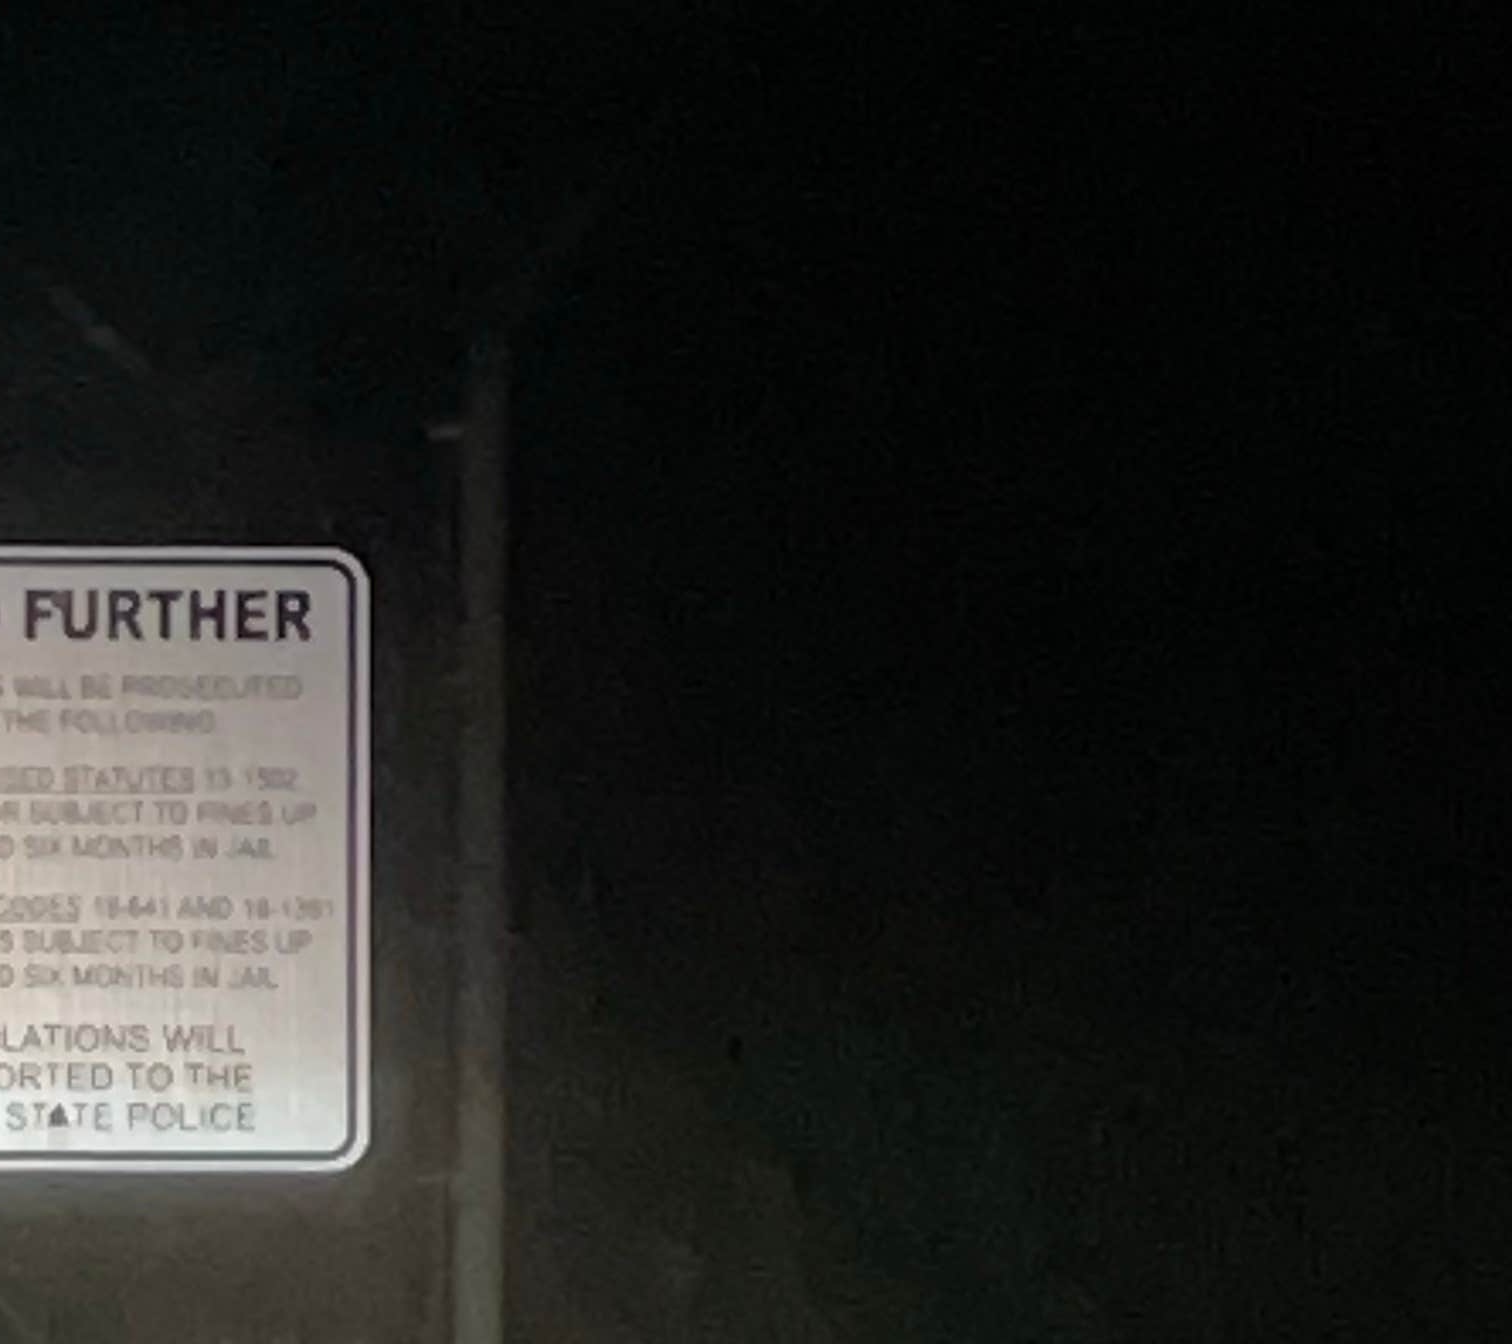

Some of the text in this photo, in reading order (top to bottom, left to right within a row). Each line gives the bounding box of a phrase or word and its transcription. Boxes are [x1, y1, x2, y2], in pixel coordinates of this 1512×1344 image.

[23, 588, 313, 643] FURTHER
[80, 674, 112, 700] BE
[1, 709, 50, 733] THE
[152, 800, 189, 826] TO
[282, 803, 317, 825] UP
[71, 834, 184, 860] MONTHS
[191, 837, 218, 859] IN
[177, 896, 234, 920] AND
[149, 930, 184, 954] TO
[275, 930, 312, 954] UP
[71, 964, 184, 989] MONTHS
[192, 965, 220, 988] IN
[162, 1024, 245, 1056] WILL
[125, 1061, 174, 1093] TO
[187, 1062, 252, 1093] THE
[5, 1102, 112, 1133] STATE
[126, 1102, 255, 1132] POLICE
